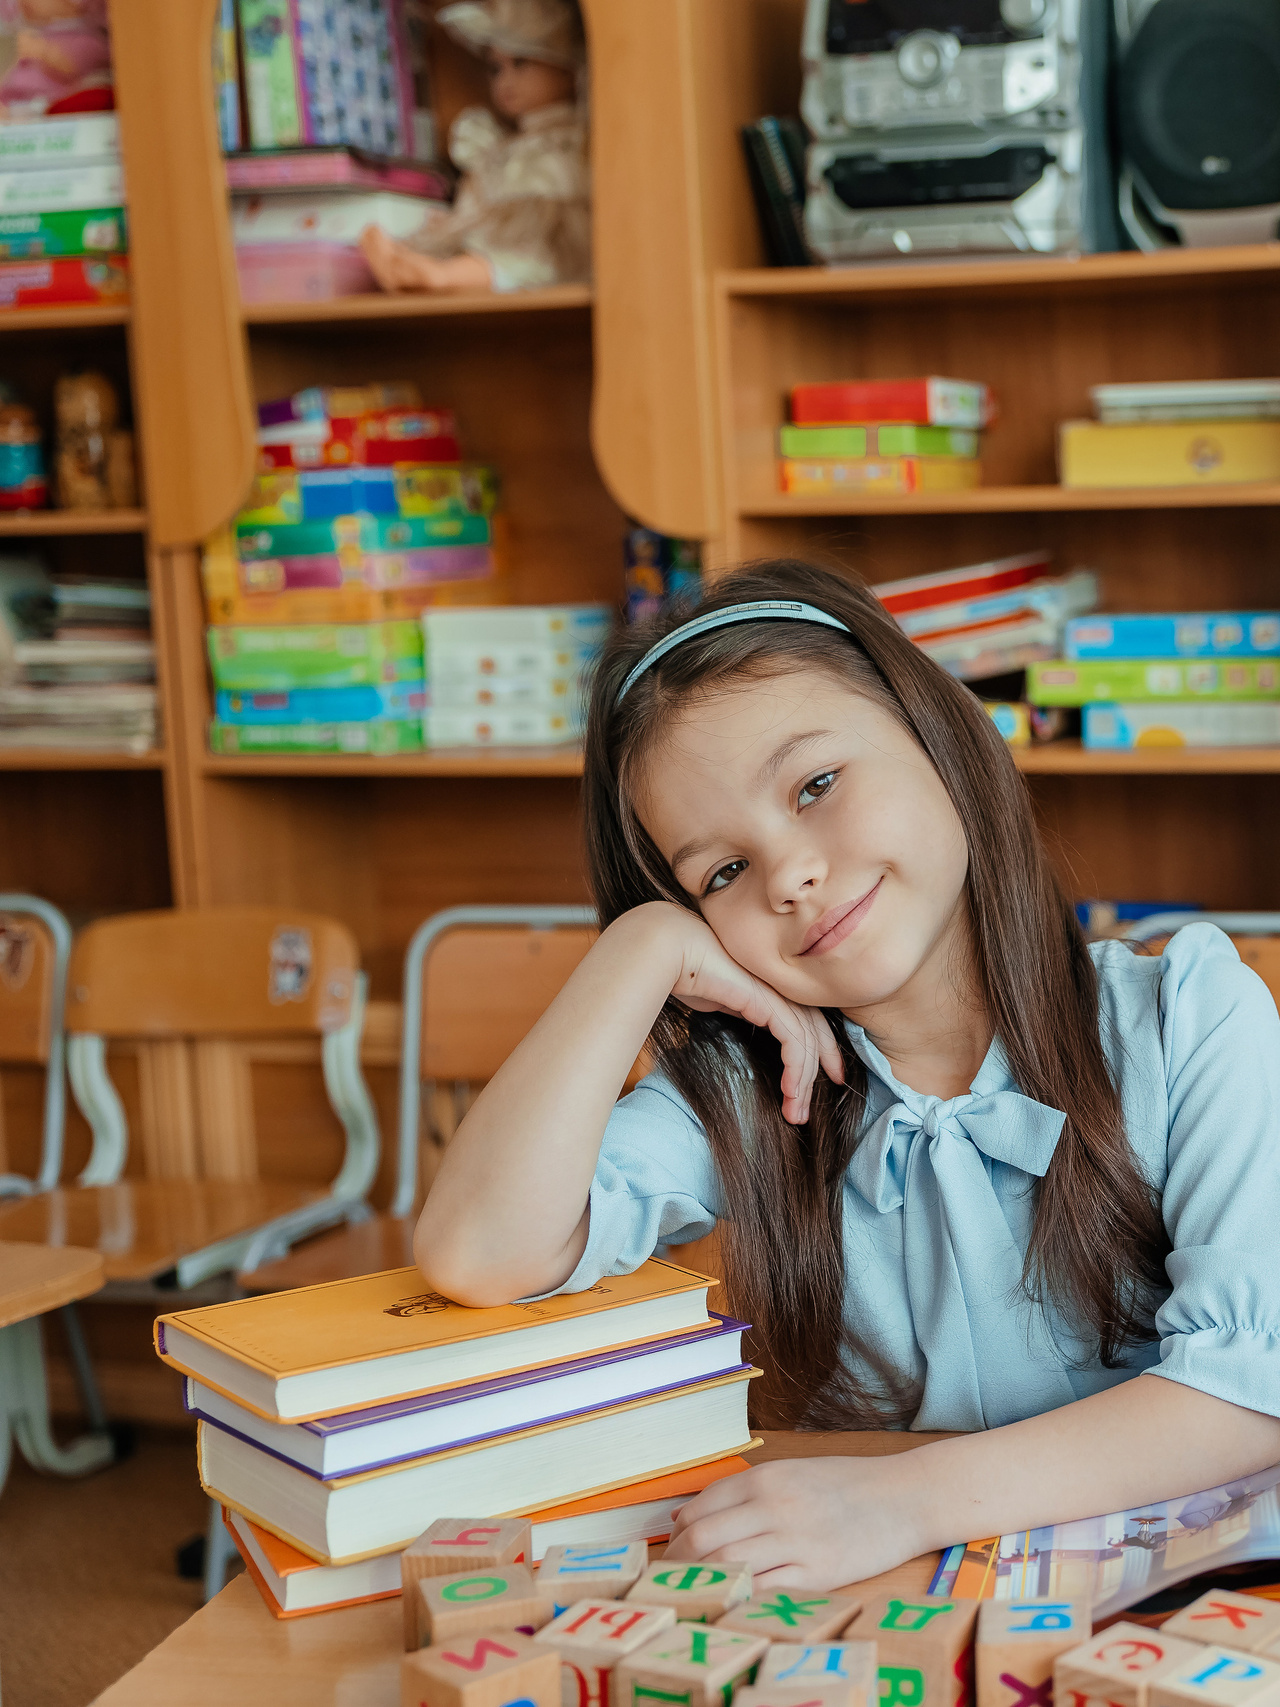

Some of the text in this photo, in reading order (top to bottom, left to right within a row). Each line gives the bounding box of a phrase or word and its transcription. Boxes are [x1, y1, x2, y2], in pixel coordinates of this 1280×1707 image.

[441, 1576, 508, 1602] О
[652, 1566, 727, 1591] Ф
[1190, 1601, 1263, 1630] К
